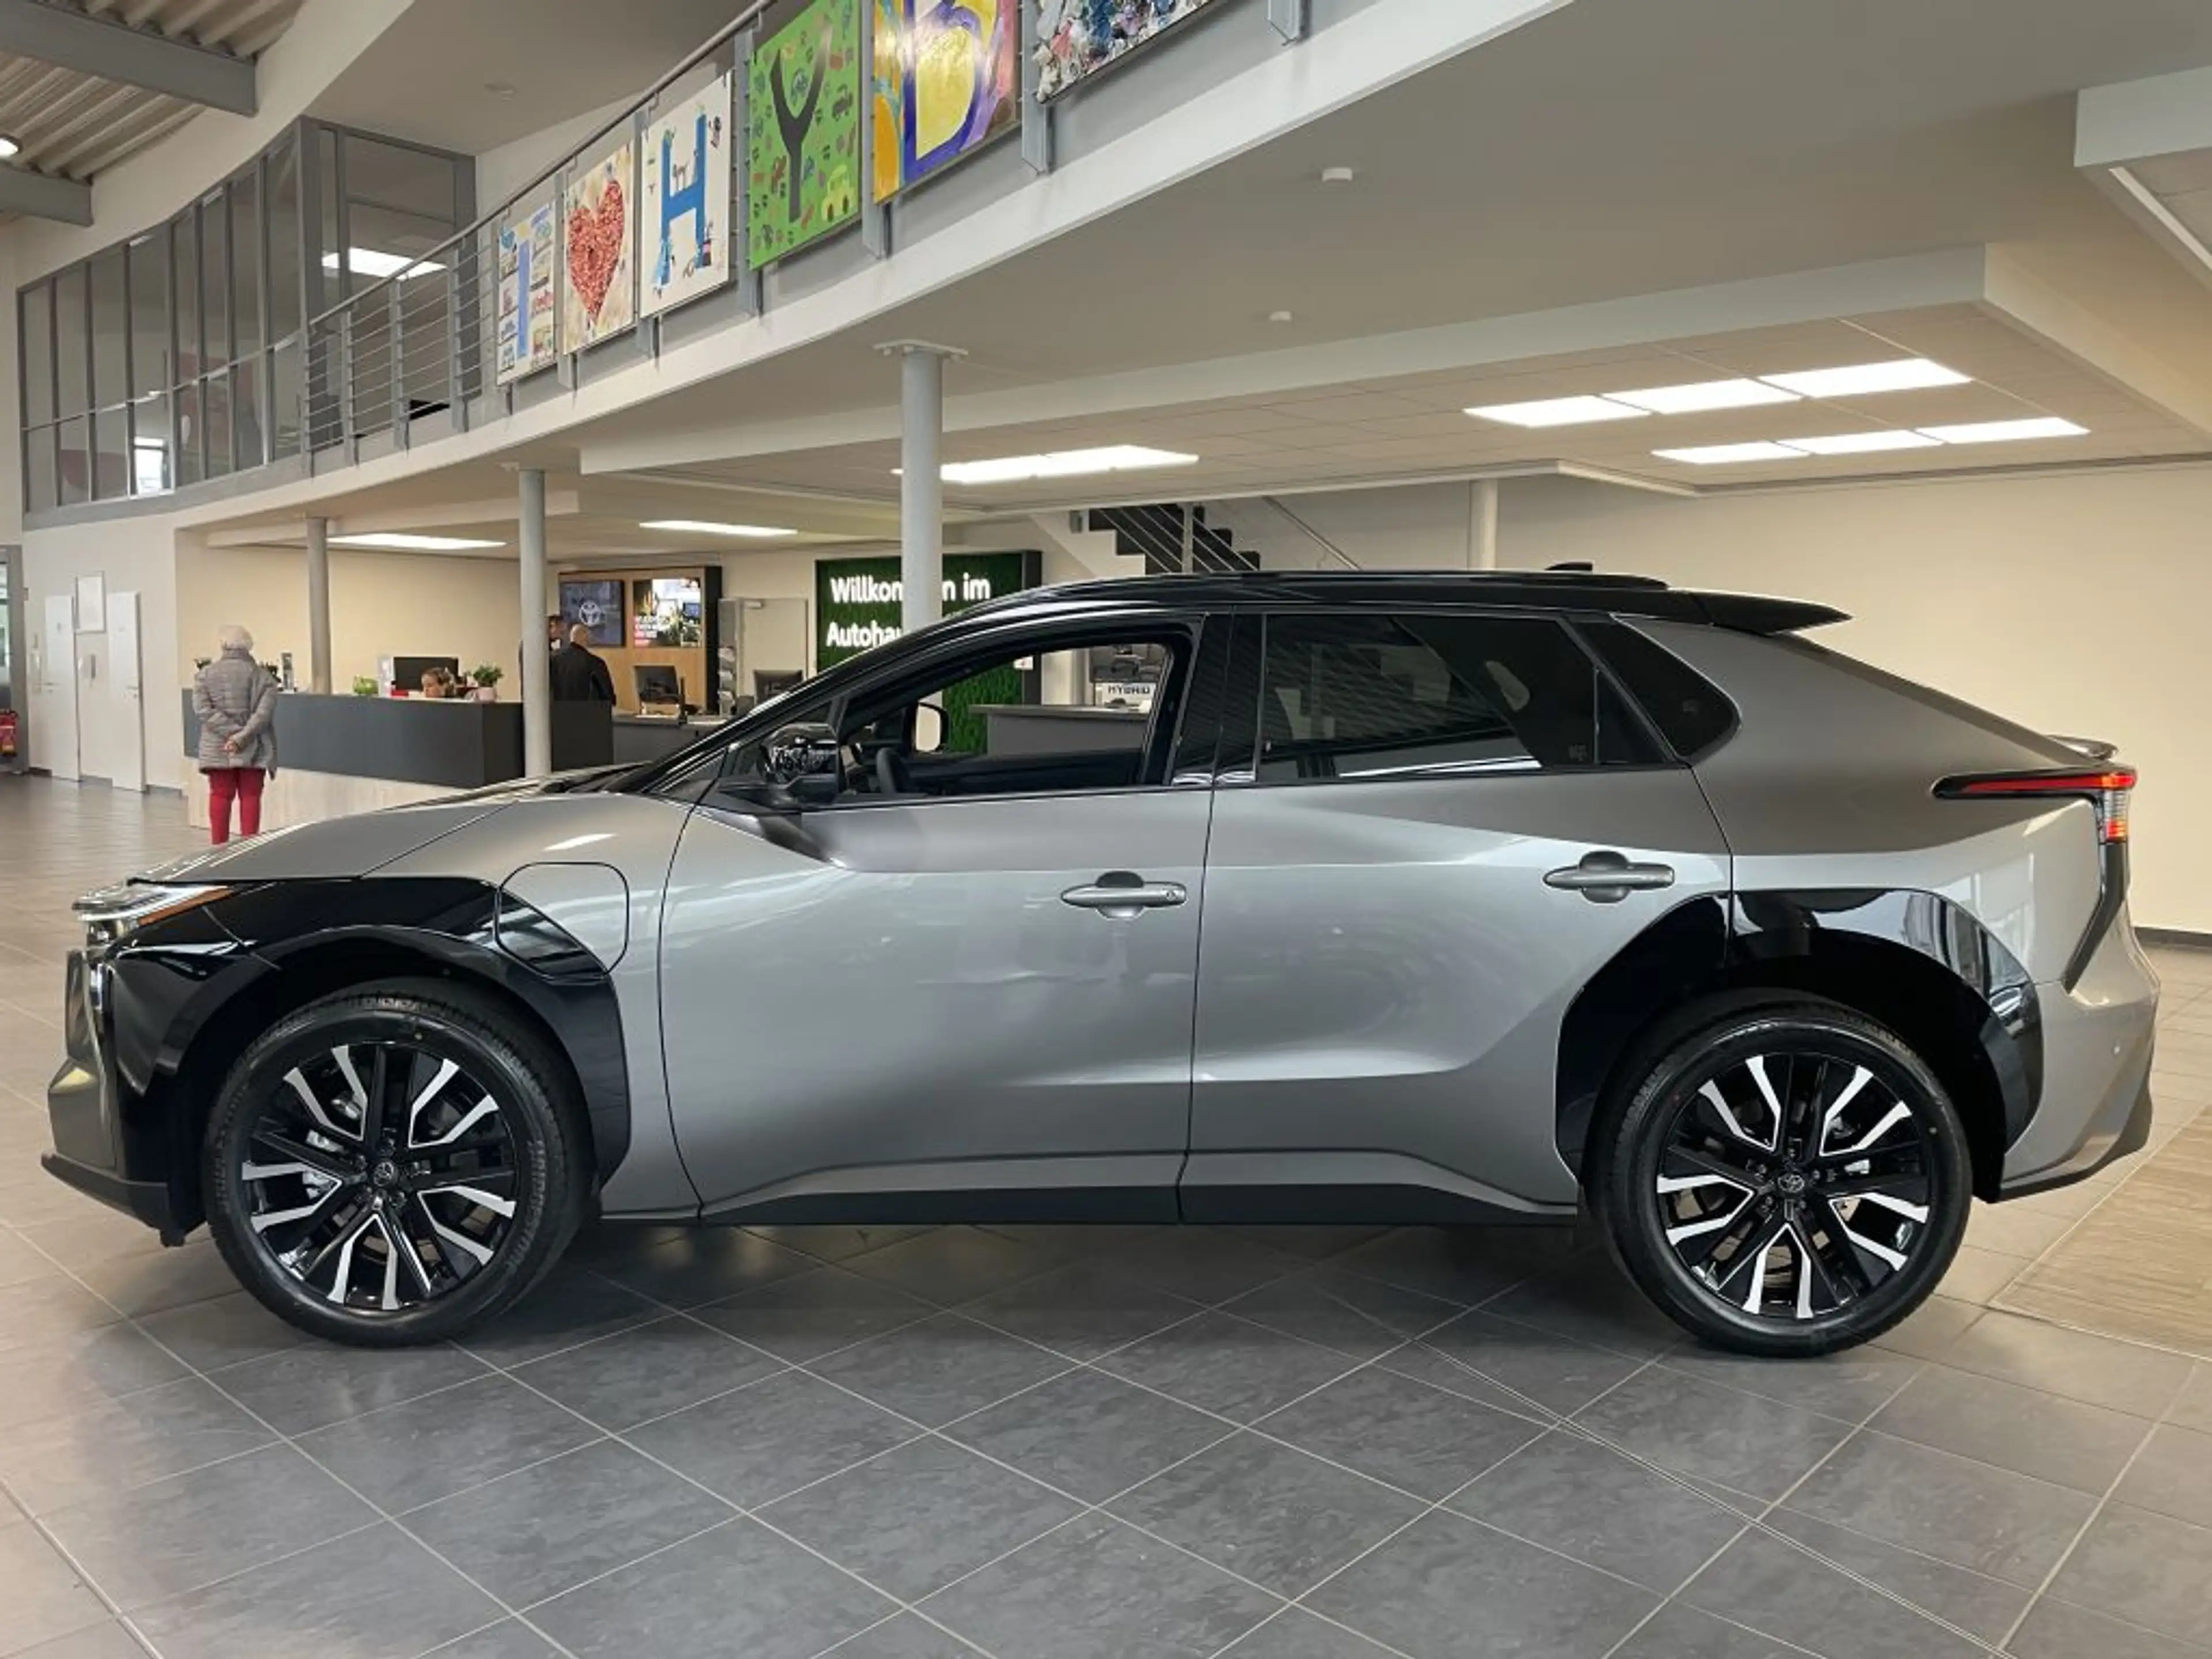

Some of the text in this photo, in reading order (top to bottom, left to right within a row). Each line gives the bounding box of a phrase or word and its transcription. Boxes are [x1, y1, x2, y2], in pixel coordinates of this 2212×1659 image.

[661, 113, 707, 285] H
[770, 20, 833, 223] Y
[830, 572, 990, 603] Willkomn im
